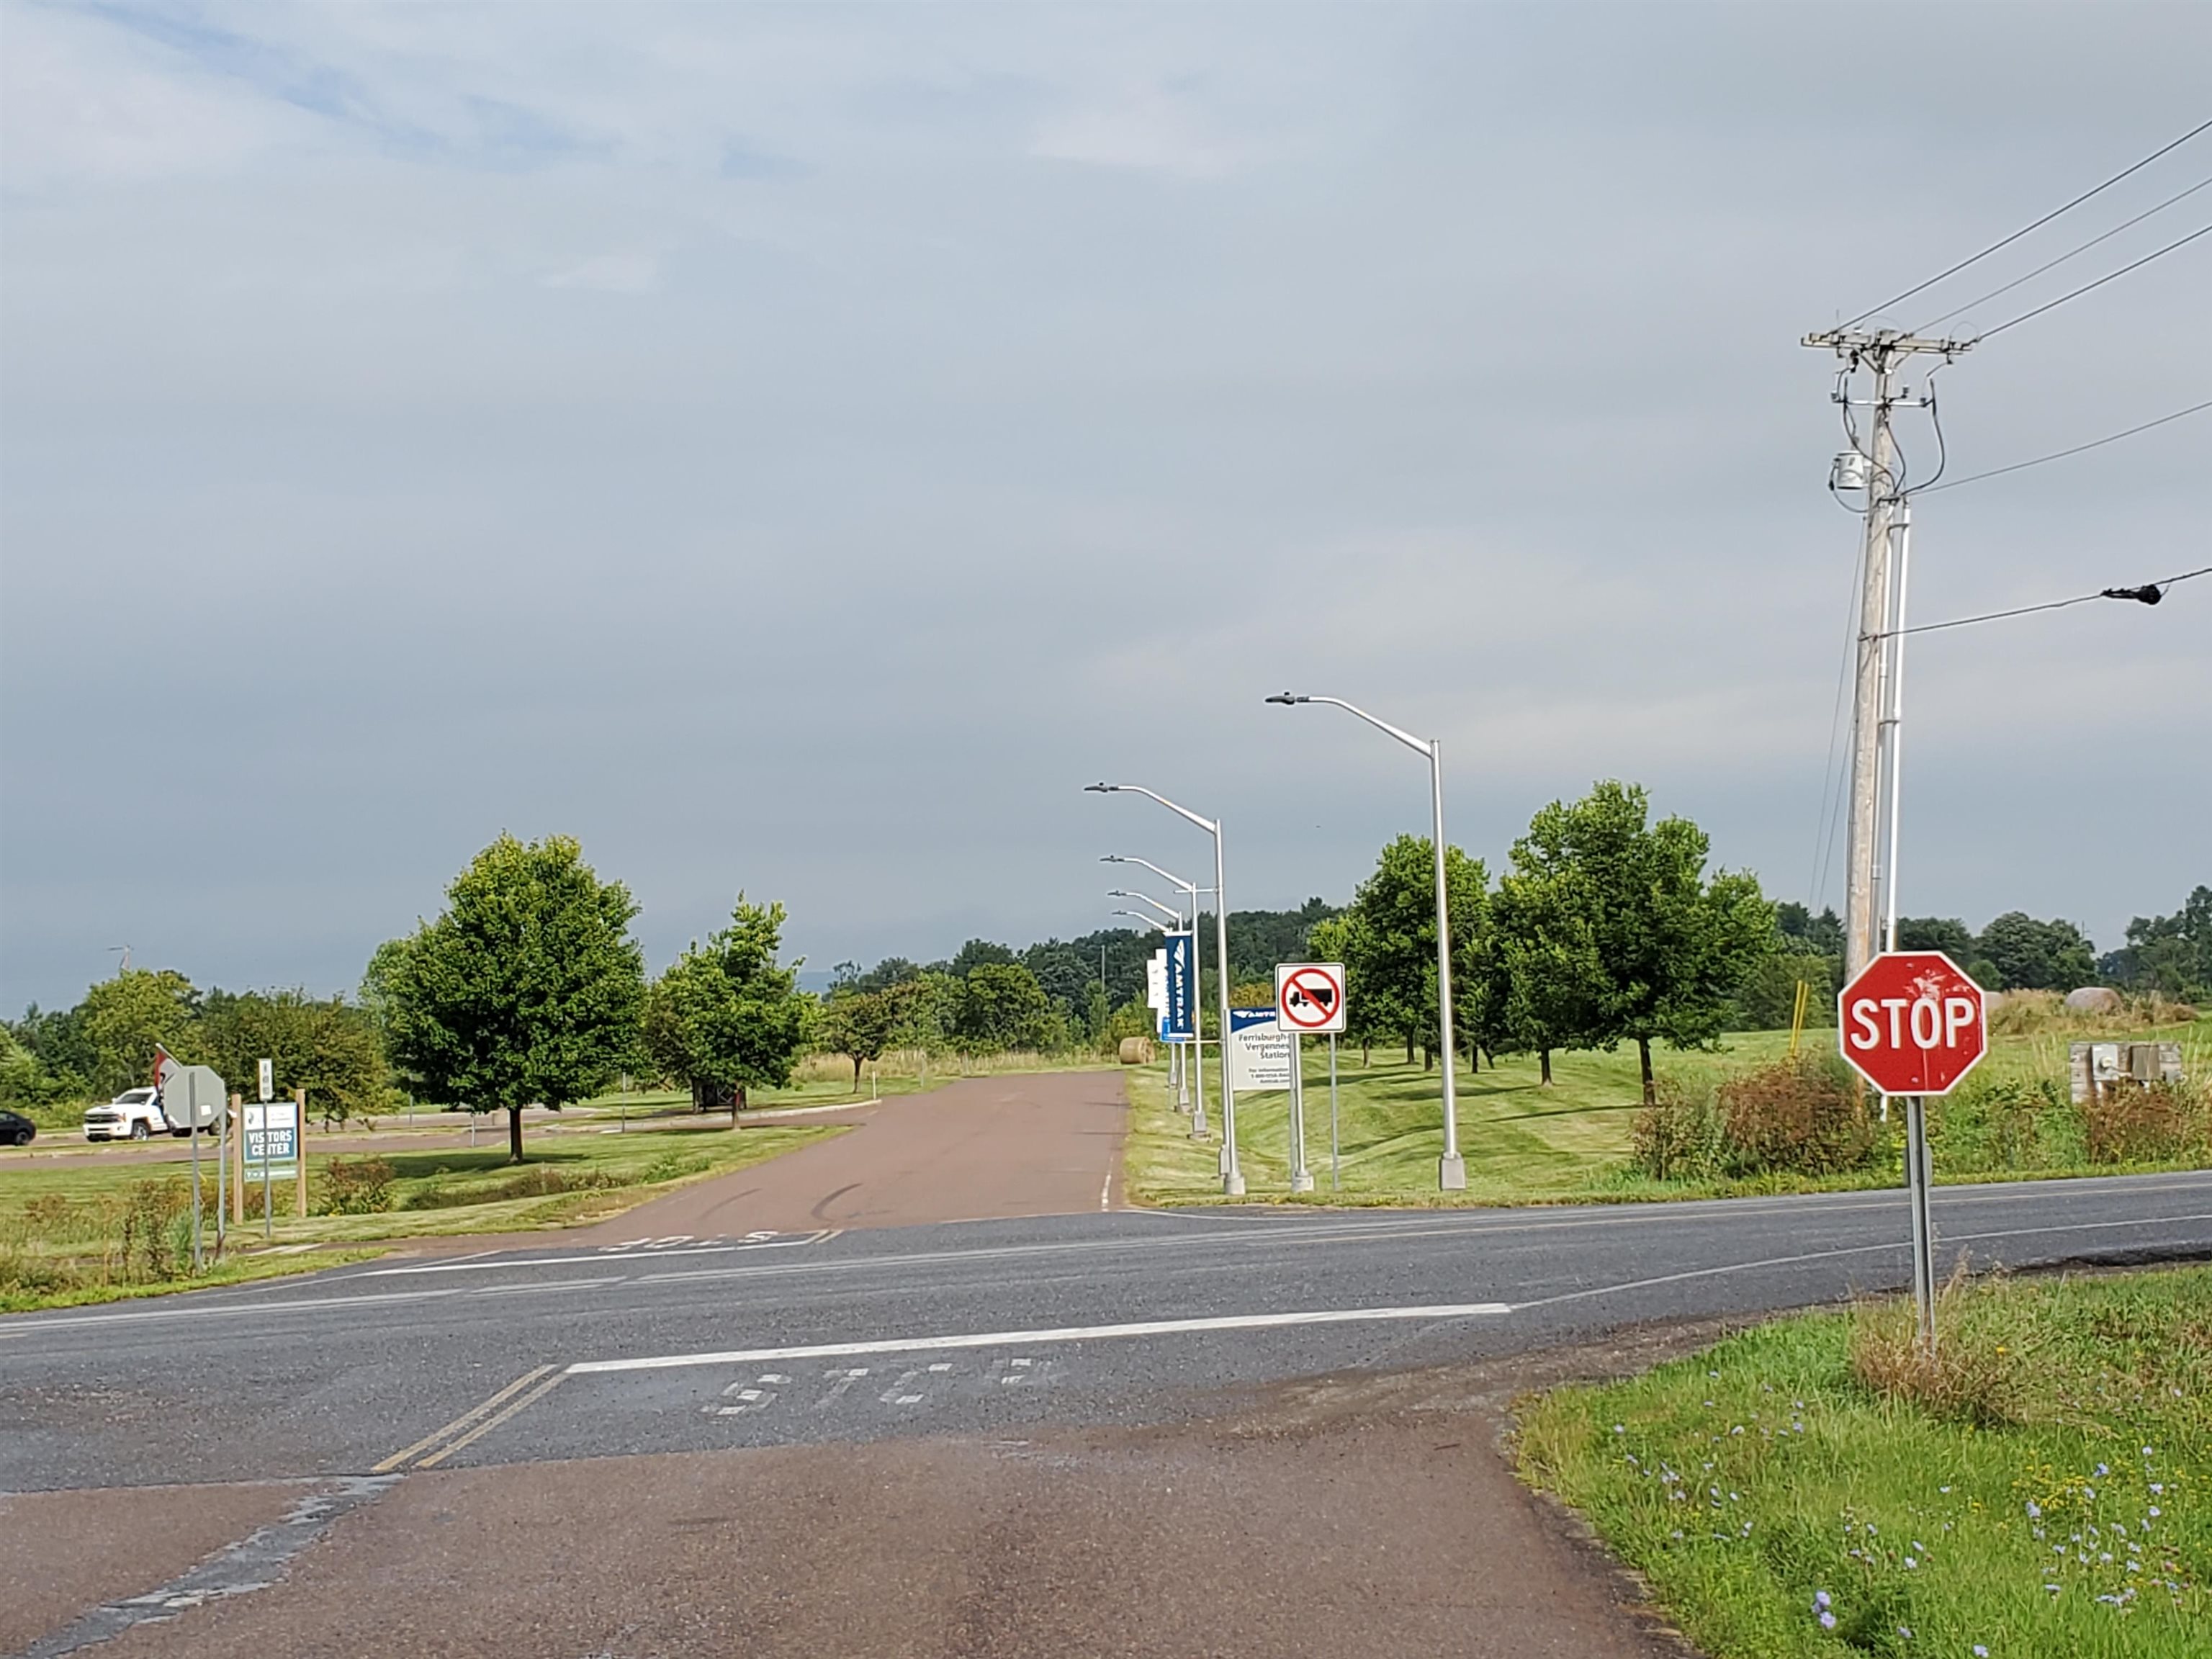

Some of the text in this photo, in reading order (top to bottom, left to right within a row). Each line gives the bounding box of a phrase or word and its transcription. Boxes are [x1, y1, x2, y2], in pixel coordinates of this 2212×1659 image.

[1174, 963, 1184, 1030] AMTRAK
[1850, 997, 1975, 1051] STOP
[248, 1130, 292, 1144] VISTORS
